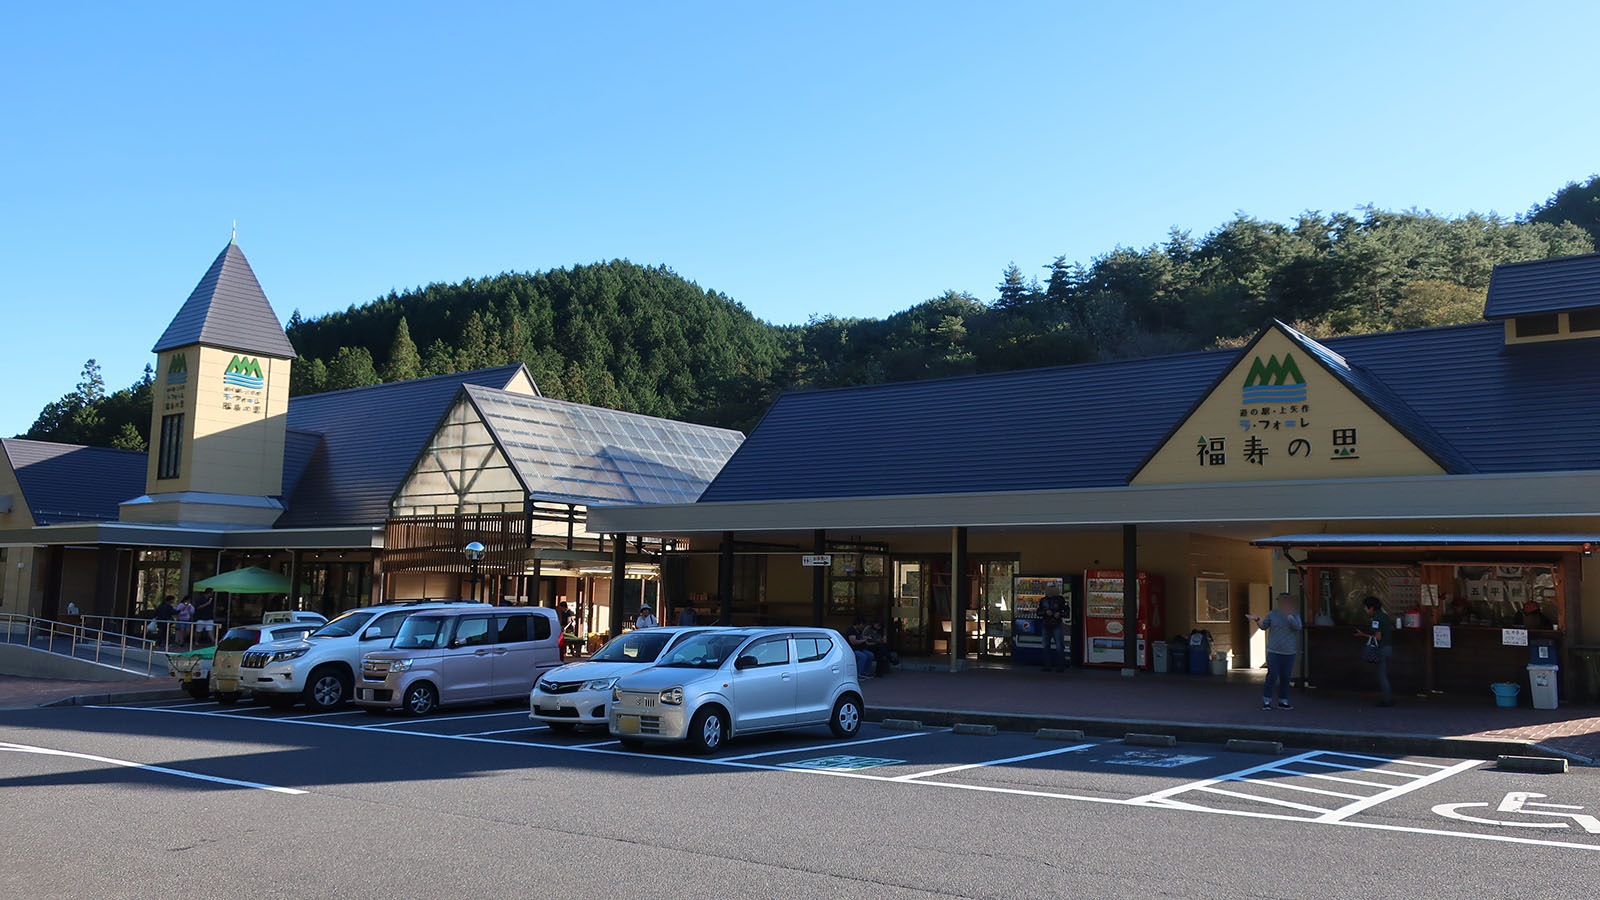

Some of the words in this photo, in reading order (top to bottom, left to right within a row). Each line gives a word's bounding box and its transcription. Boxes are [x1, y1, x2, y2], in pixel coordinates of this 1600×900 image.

[1240, 405, 1310, 417] 道の駅・上矢作
[1196, 428, 1359, 466] 福寿の里
